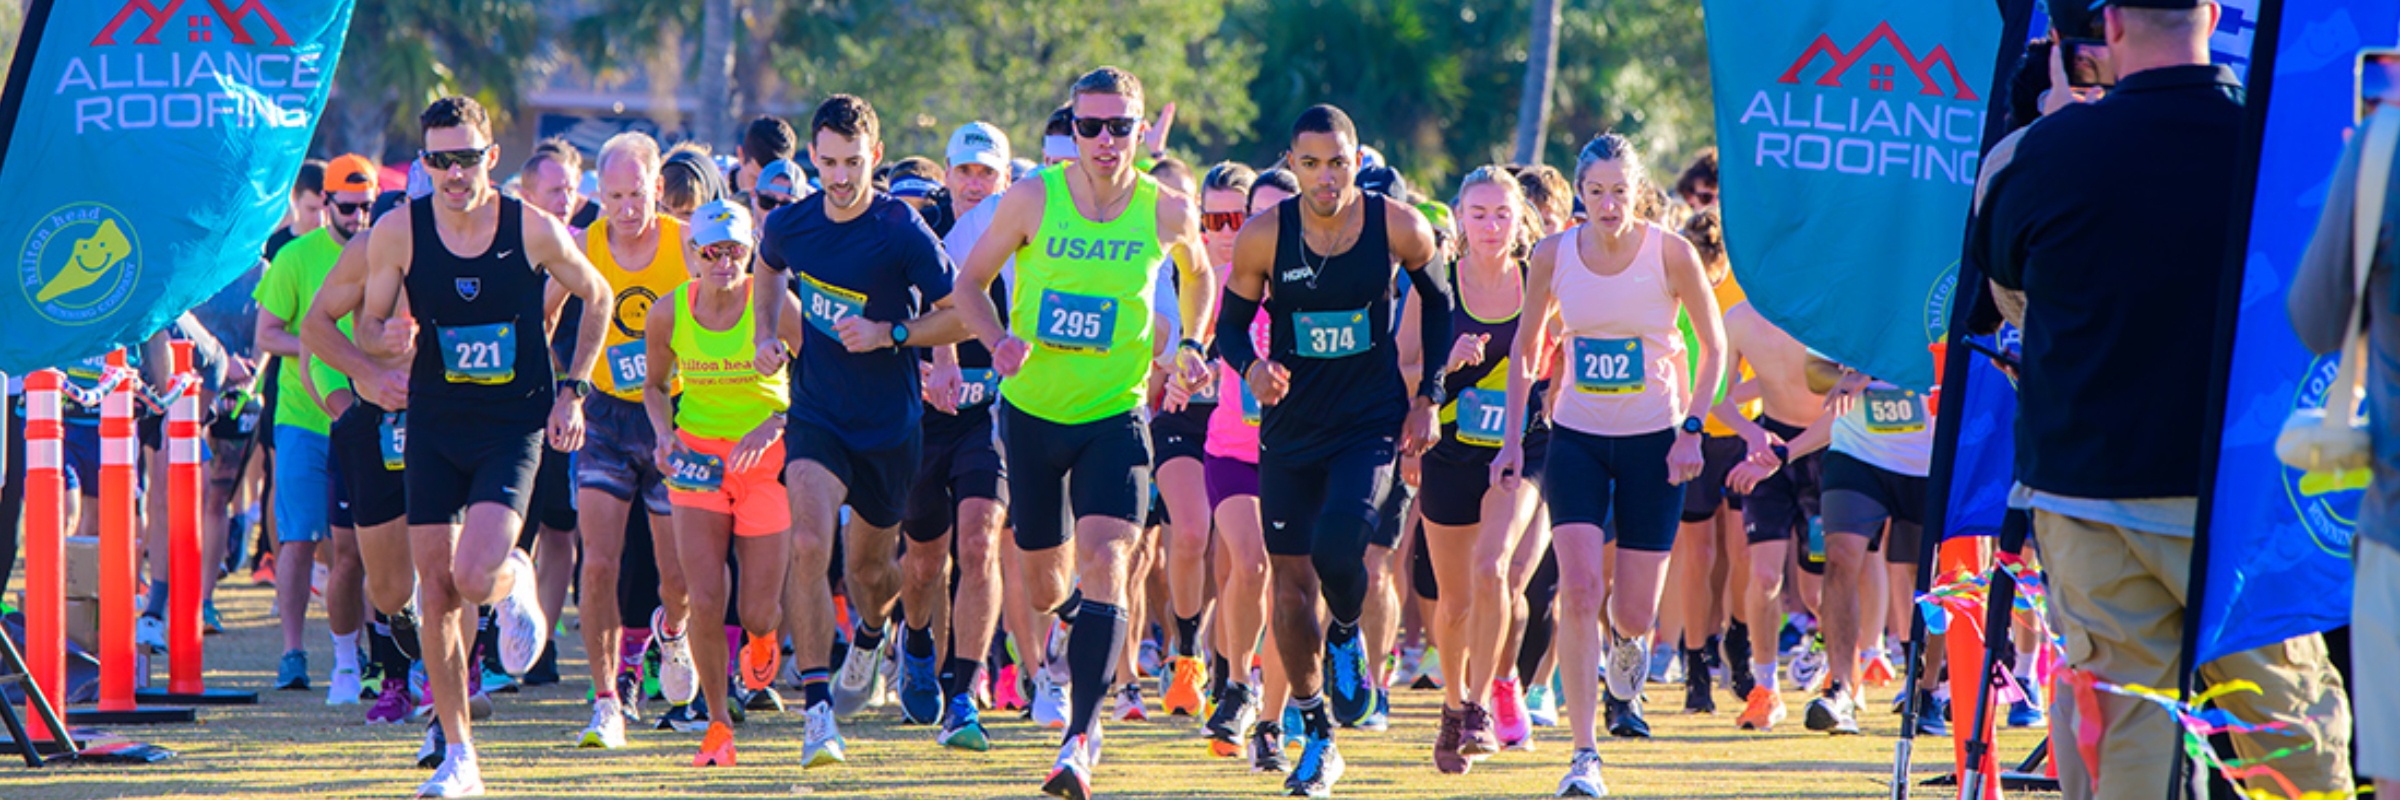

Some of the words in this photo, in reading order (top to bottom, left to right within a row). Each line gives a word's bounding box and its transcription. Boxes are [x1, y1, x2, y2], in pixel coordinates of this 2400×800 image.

[55, 50, 321, 95] ALLIANCE
[75, 92, 310, 134] ROOFING
[1739, 90, 1987, 143] ALLIANC
[51, 206, 101, 229] head
[1046, 235, 1145, 262] USATF
[1049, 307, 1101, 339] 295
[1310, 325, 1356, 353] 374
[456, 341, 501, 369] 221
[618, 353, 647, 381] 56
[680, 358, 720, 372] hilton
[723, 357, 754, 371] hea
[1584, 353, 1631, 379] 202
[959, 381, 985, 405] 78
[1480, 404, 1505, 431] 77
[1871, 399, 1912, 422] 530
